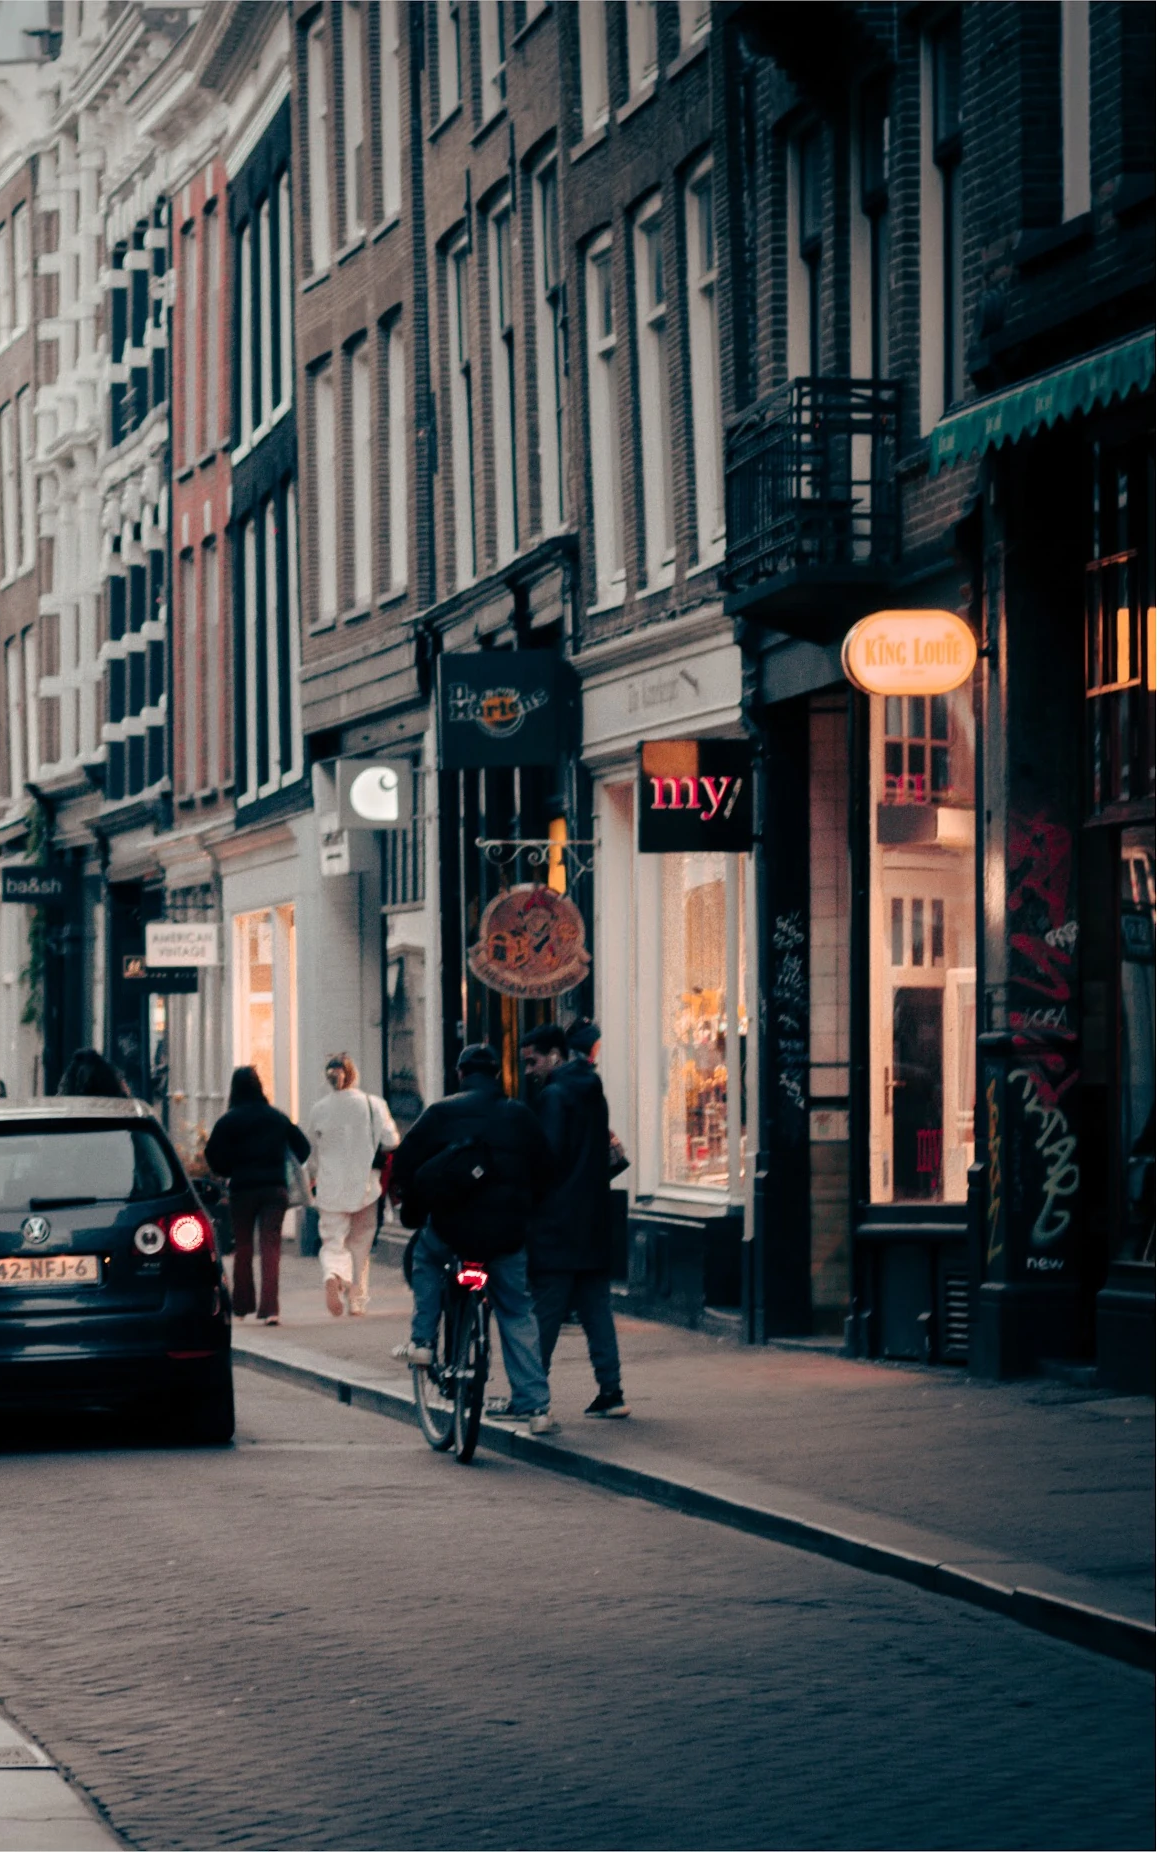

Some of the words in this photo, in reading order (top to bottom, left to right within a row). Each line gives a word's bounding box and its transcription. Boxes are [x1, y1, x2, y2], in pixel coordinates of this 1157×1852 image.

[5, 876, 62, 894] ba&sh
[152, 931, 213, 945] AMERICAN
[158, 945, 207, 958] VINTAGE
[1026, 1256, 1064, 1270] new
